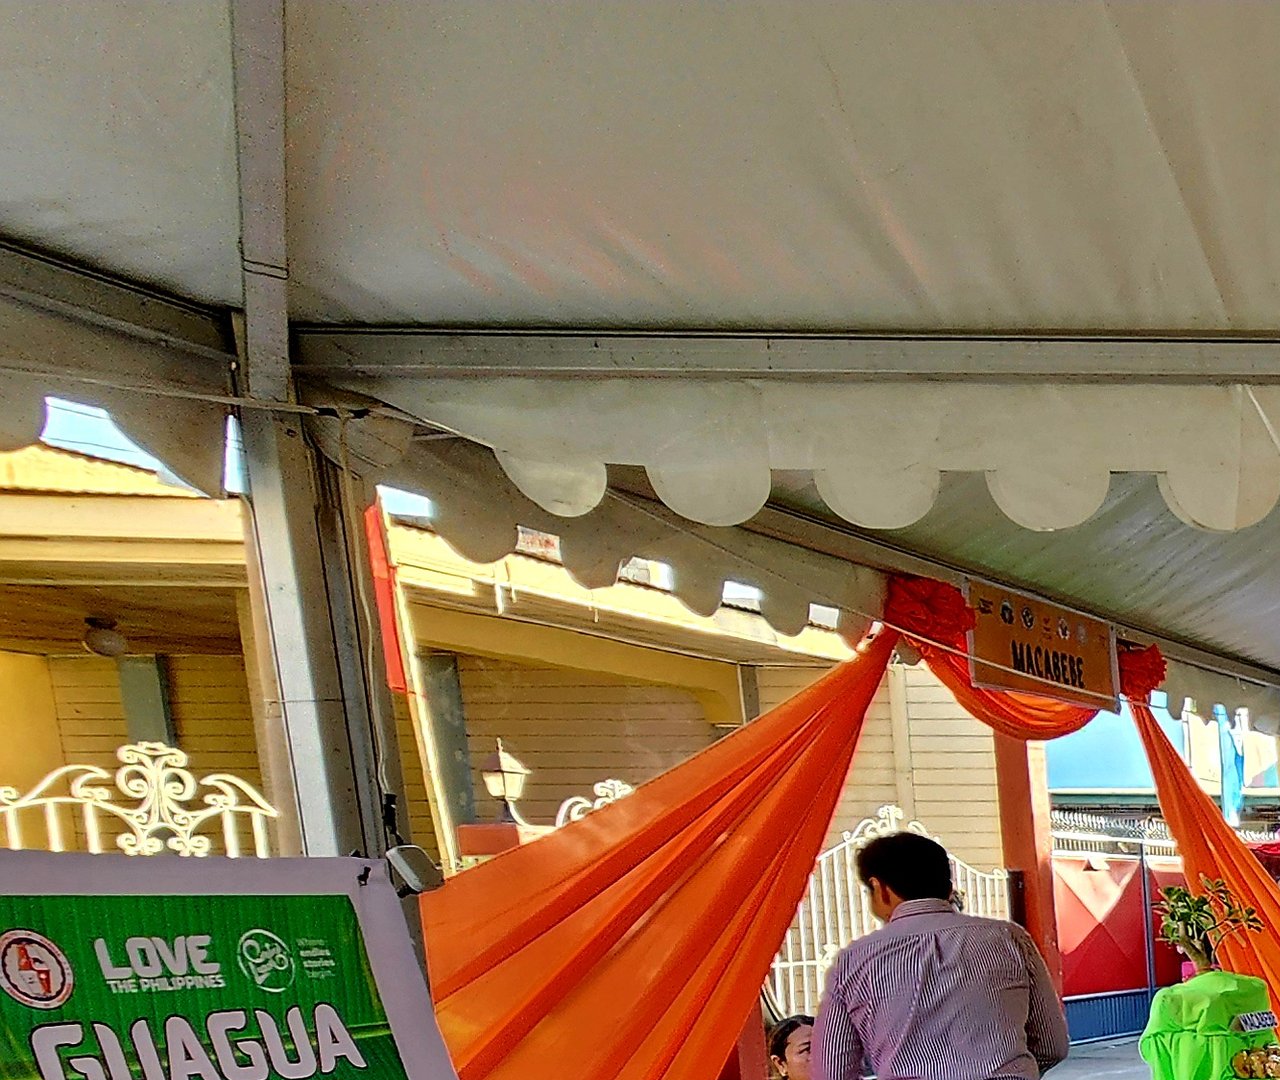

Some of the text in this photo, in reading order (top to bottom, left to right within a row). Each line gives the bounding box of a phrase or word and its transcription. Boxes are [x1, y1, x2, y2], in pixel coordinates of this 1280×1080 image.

[1011, 640, 1085, 688] MACABEBE
[94, 935, 220, 979] LOVE
[106, 975, 226, 993] THE PHILIPPINES
